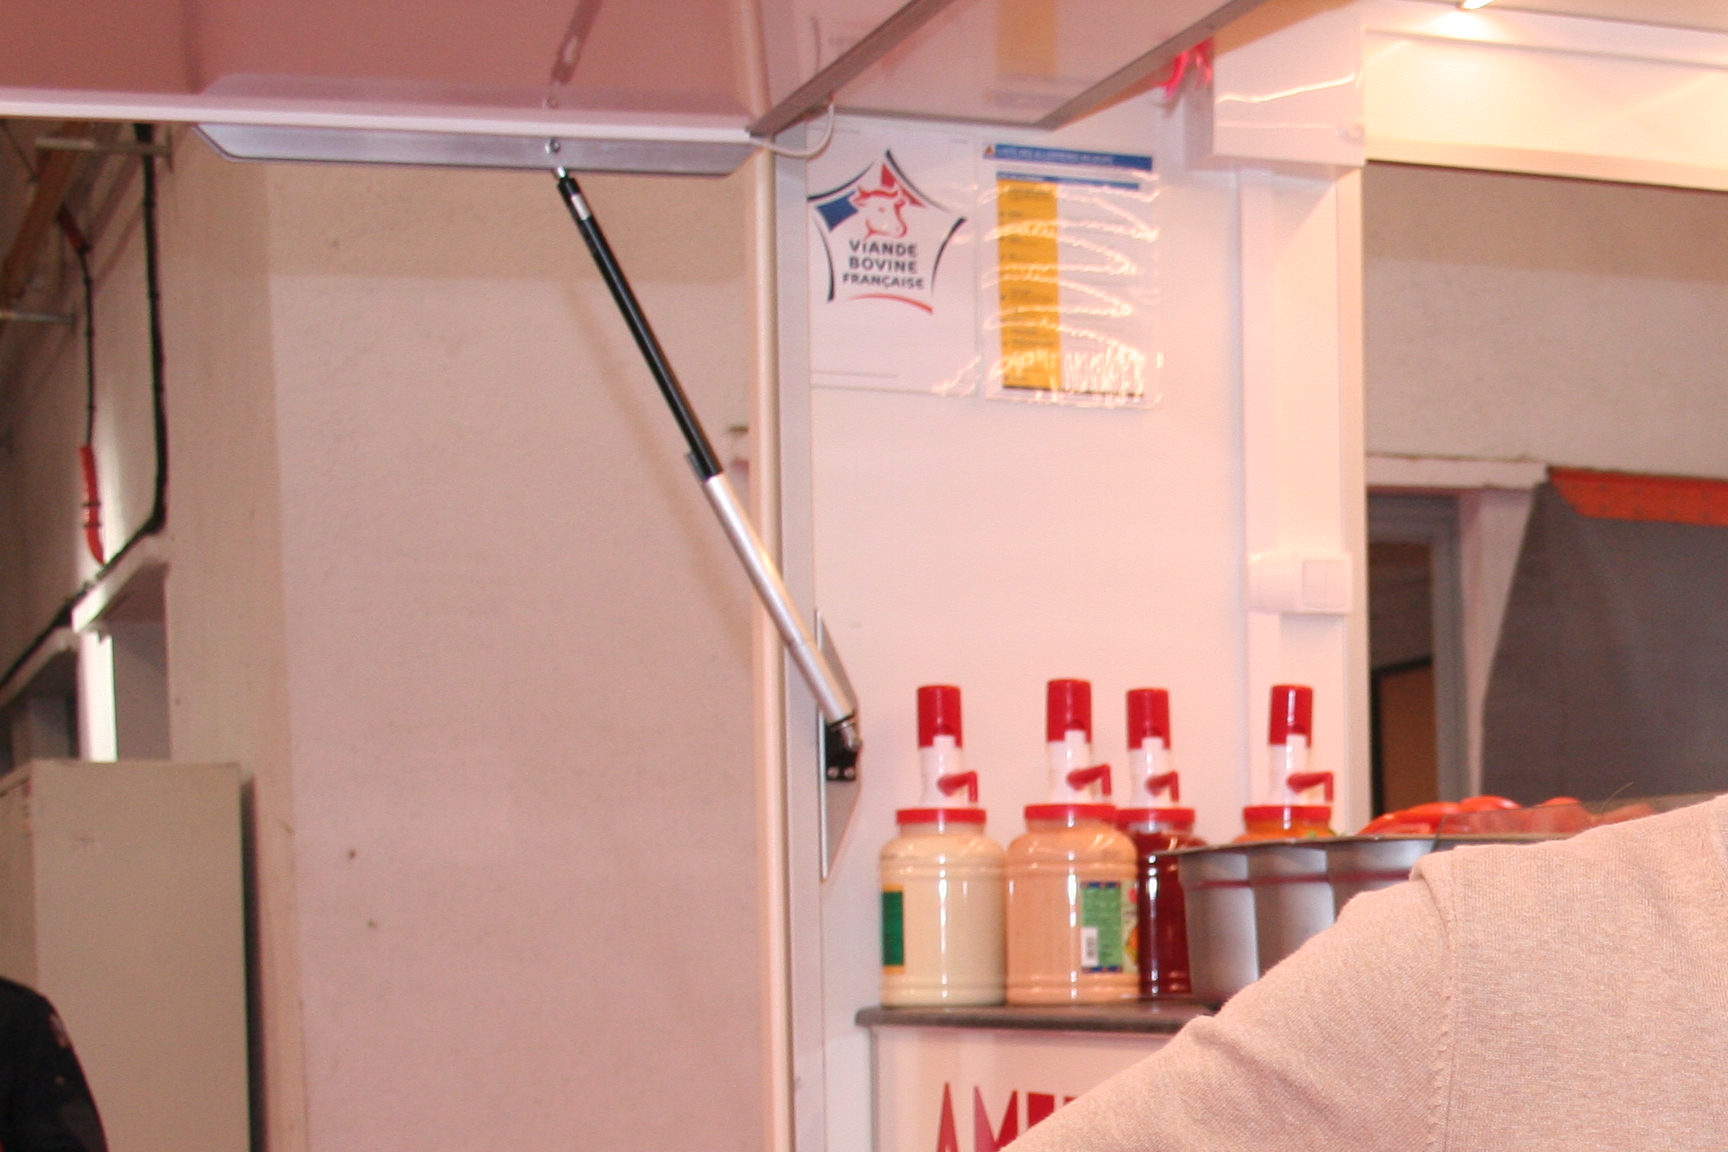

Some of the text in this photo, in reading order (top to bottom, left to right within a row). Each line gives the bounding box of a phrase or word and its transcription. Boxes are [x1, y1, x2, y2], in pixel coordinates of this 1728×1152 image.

[848, 239, 918, 258] VIANDE
[848, 255, 917, 274] BOVINE
[842, 272, 925, 290] FRANÇAISE
